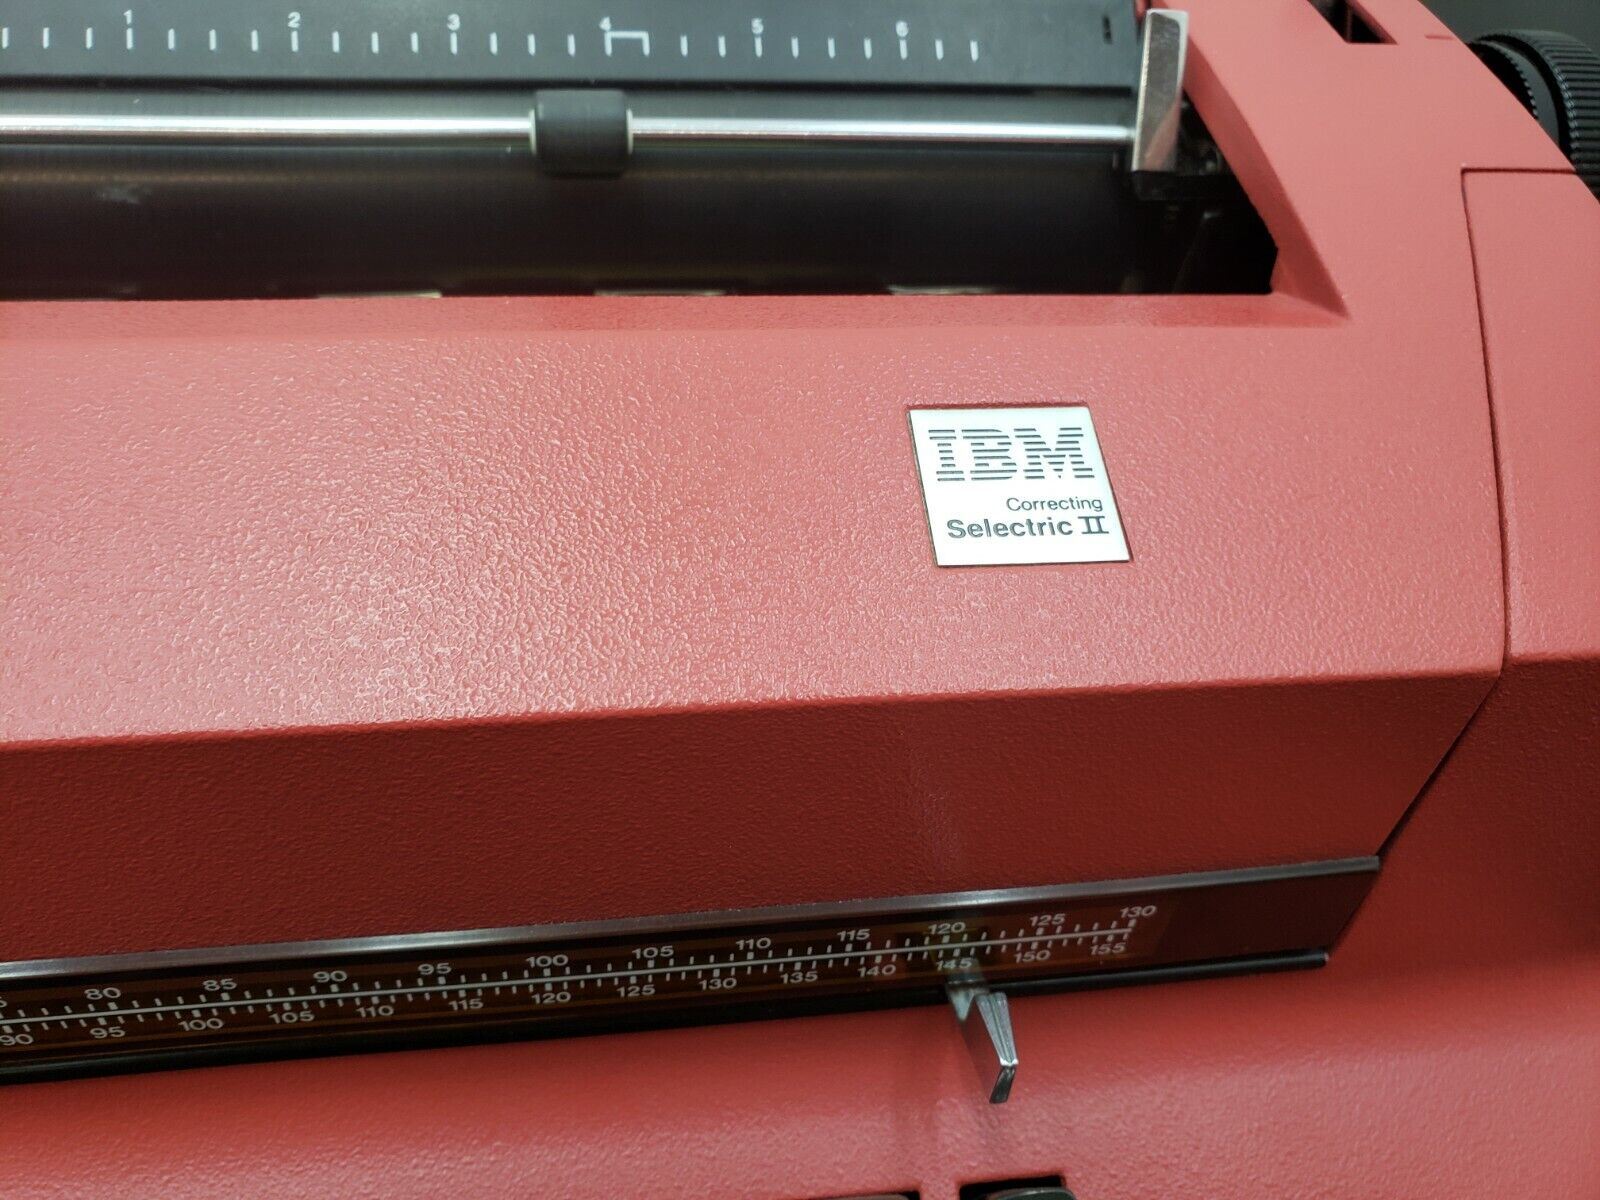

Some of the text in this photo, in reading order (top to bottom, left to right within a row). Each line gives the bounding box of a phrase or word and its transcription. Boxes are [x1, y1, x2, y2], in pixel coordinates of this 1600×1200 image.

[123, 10, 133, 25] 1
[287, 12, 301, 28] 2
[447, 14, 461, 31] 3
[599, 16, 611, 31] 4
[750, 18, 764, 35] 5
[928, 427, 1095, 482] IBM
[1006, 496, 1104, 512] Correcting
[946, 516, 1109, 539] Selectric II
[84, 904, 1157, 1000] 80 85 90 95 100 105 110 115 120 125 130
[0, 942, 1126, 1046] 90 95 100 105 110 115 120 125 130 135 140 145 150 155
